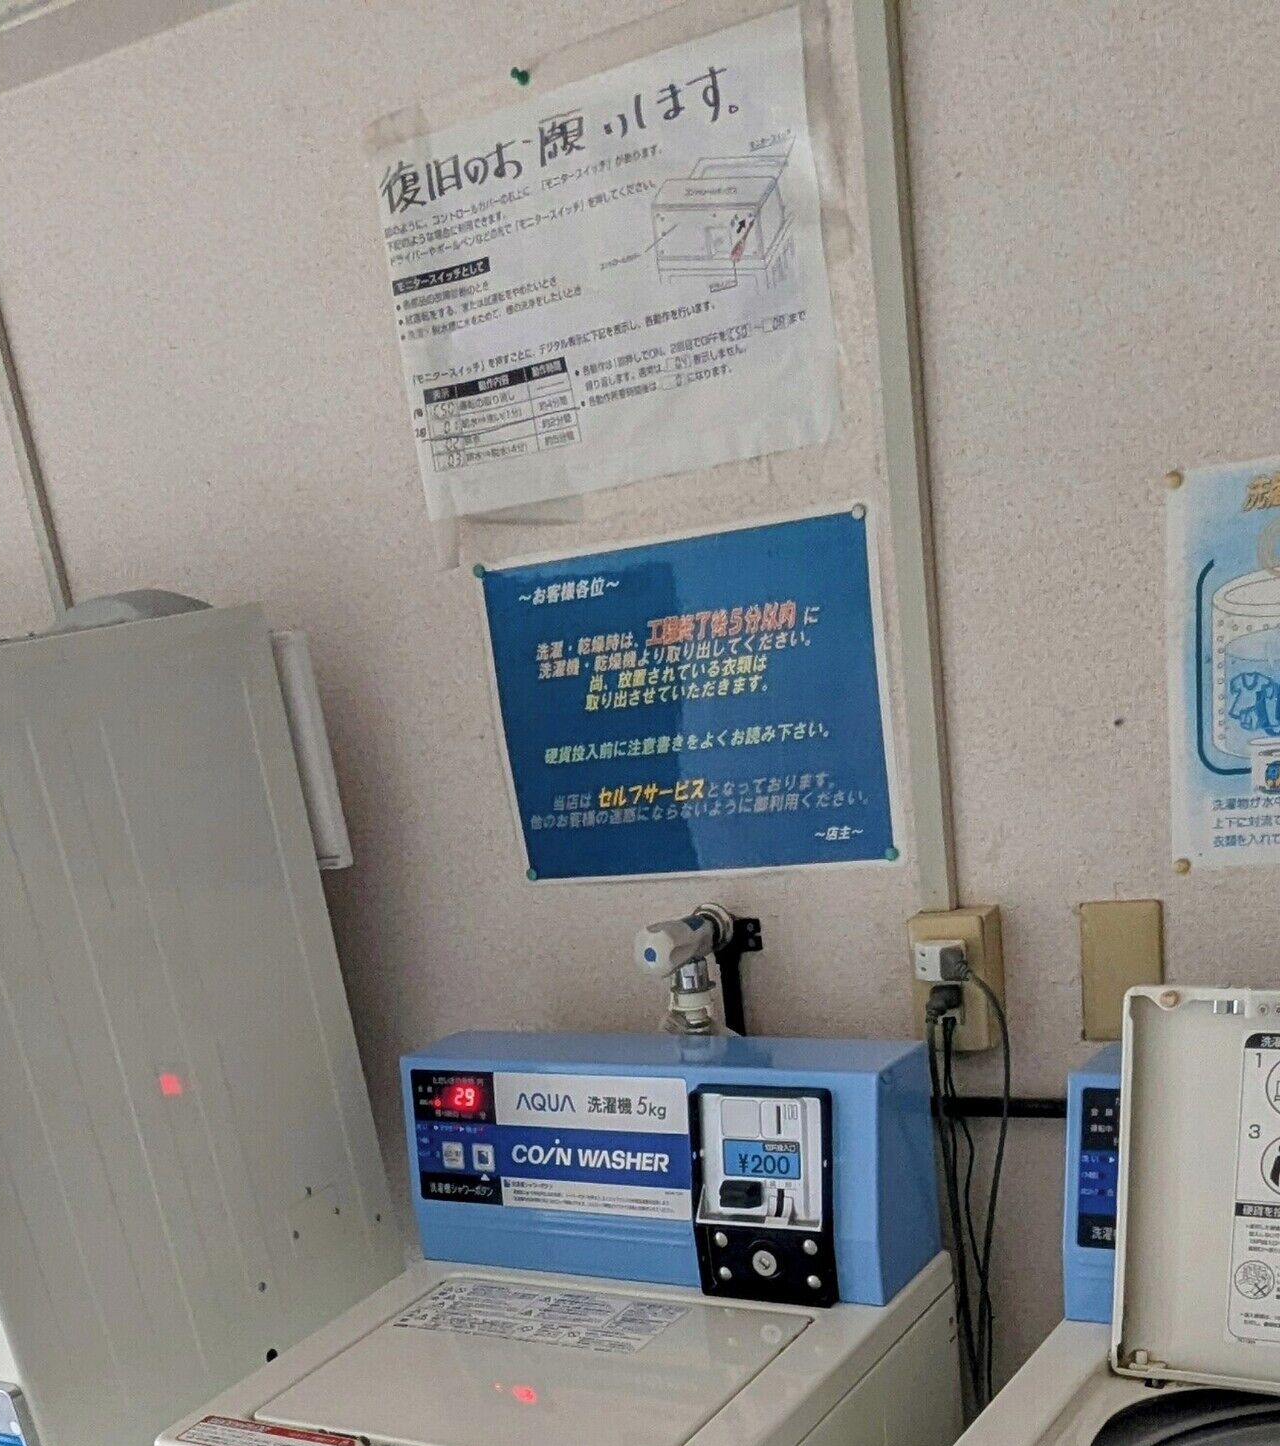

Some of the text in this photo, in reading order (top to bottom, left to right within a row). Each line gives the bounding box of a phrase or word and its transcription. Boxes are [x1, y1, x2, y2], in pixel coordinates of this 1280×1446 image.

[598, 778, 705, 809] セルフサービス
[1255, 1053, 1262, 1068] 1
[454, 1086, 475, 1107] 29
[516, 1092, 667, 1120] AQUA 洗濯機 5kg
[1248, 1124, 1261, 1139] 3
[511, 1138, 670, 1173] COIN WASHER
[738, 1153, 791, 1175] ¥200
